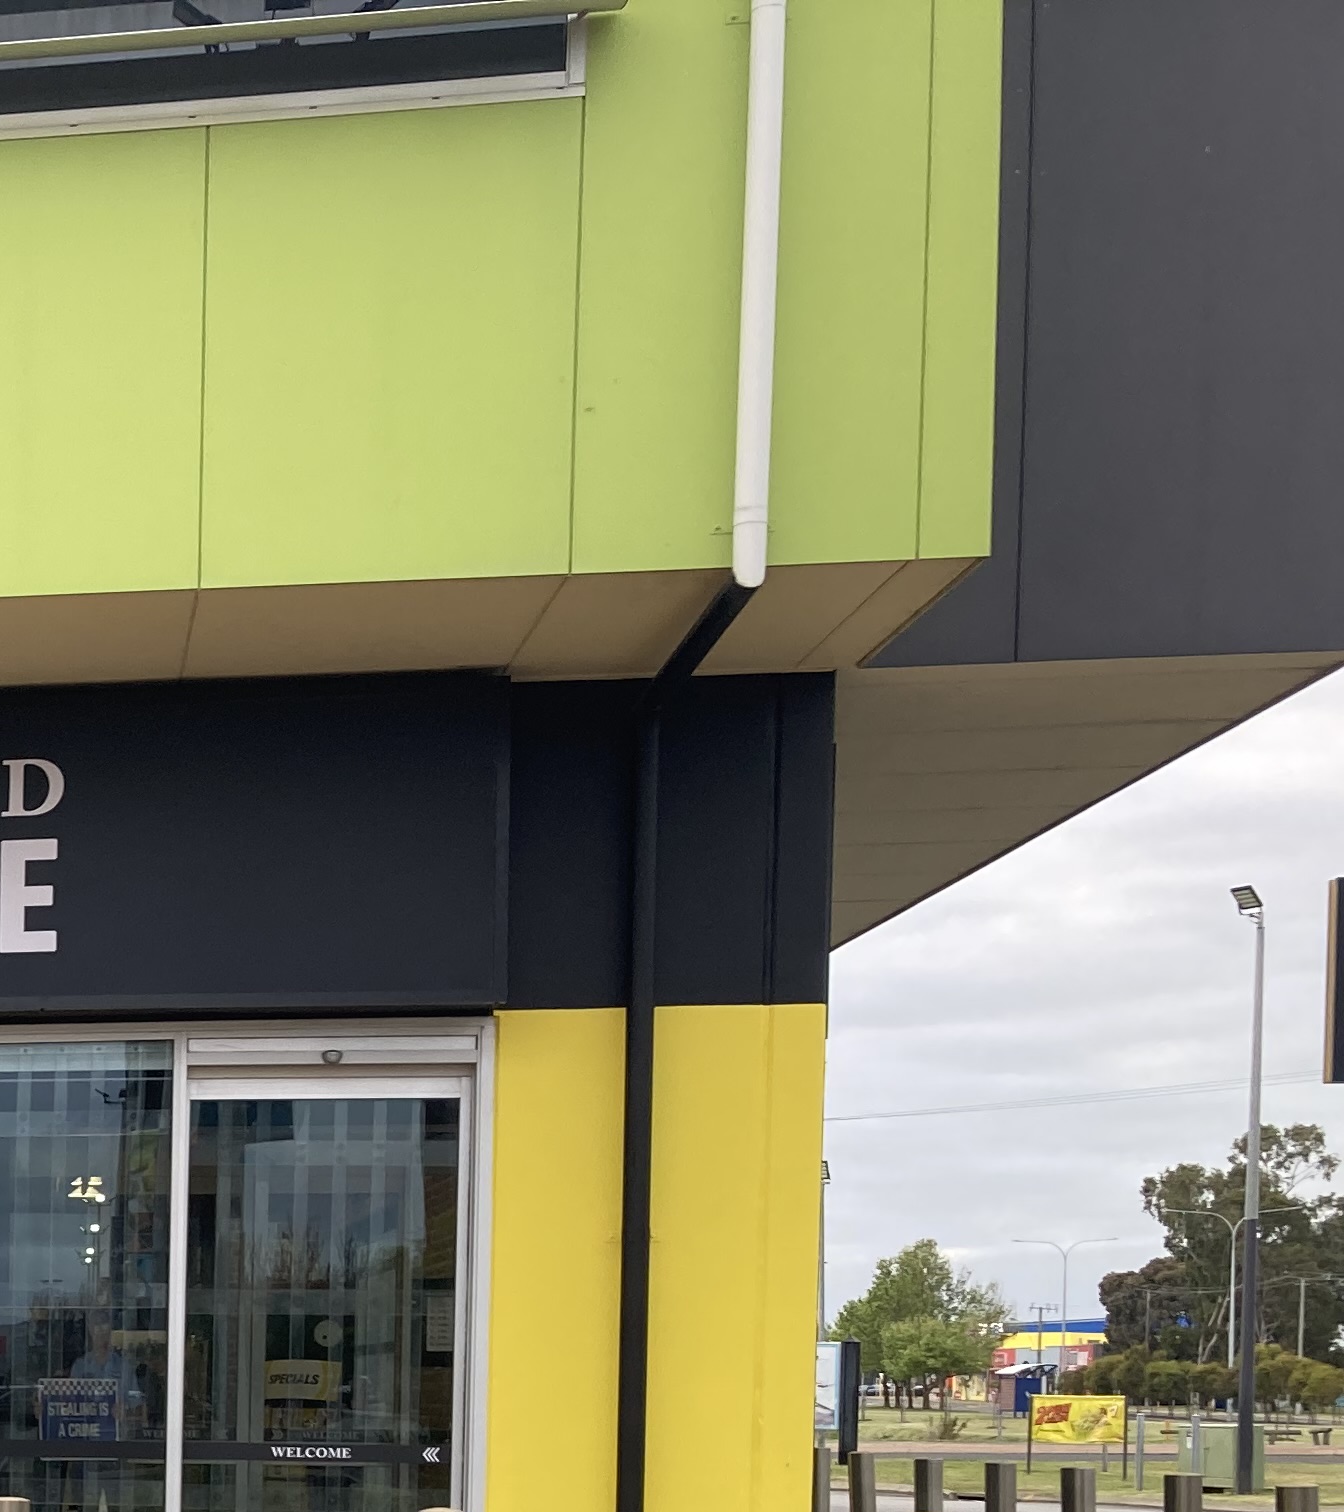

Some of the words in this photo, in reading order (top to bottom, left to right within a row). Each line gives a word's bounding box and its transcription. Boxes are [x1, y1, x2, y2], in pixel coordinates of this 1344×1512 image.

[268, 1373, 320, 1385] SPECIALS
[99, 1402, 109, 1416] IS
[270, 1446, 352, 1459] WELCOME
